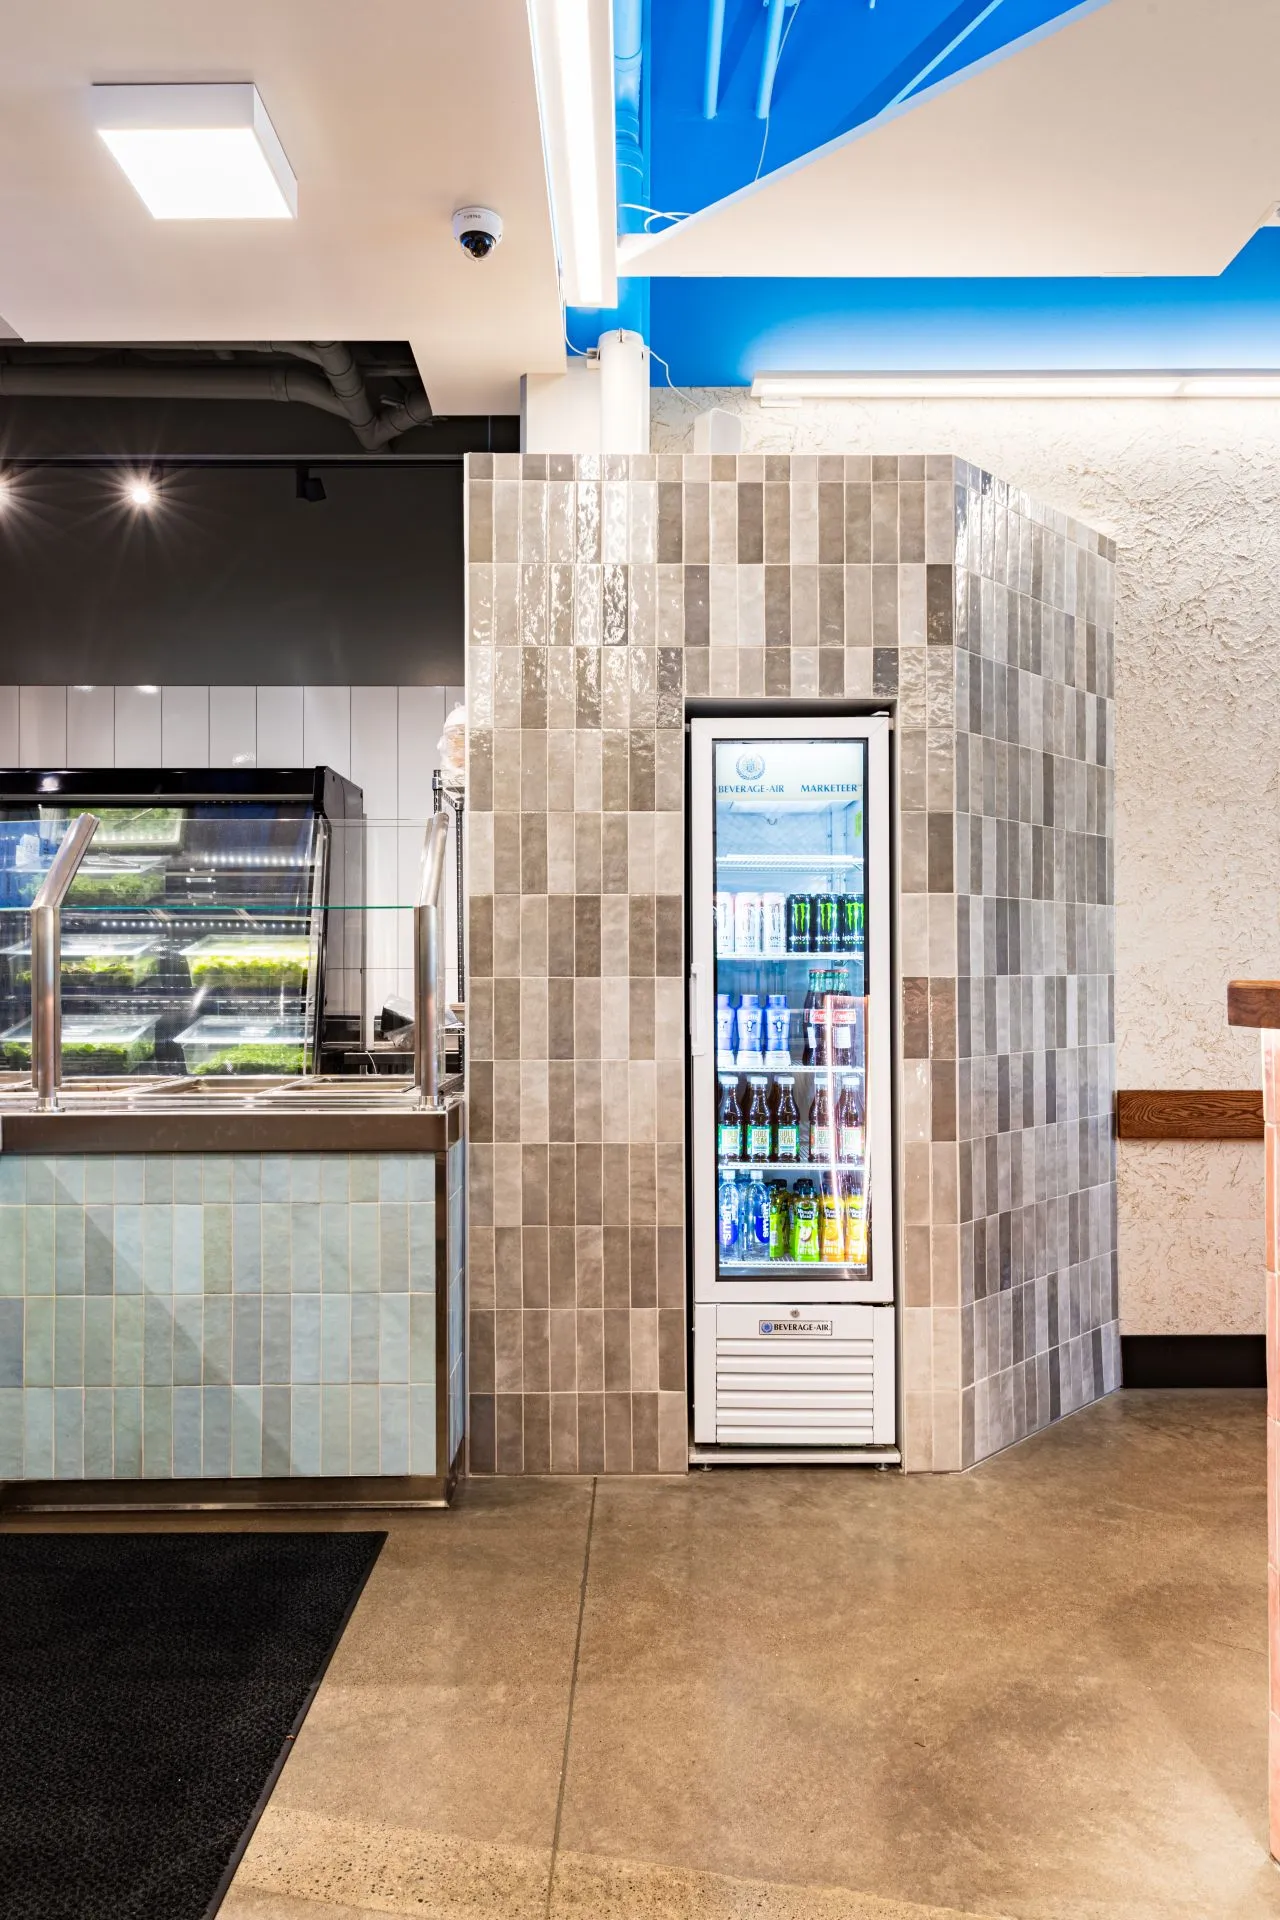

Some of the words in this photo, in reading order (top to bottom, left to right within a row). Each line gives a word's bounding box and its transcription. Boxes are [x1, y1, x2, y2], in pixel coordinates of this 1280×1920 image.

[718, 785, 785, 793] BEVERAGE-AIR
[800, 784, 858, 792] MARKETEER
[773, 1323, 829, 1331] BEVERAGE-AIR
